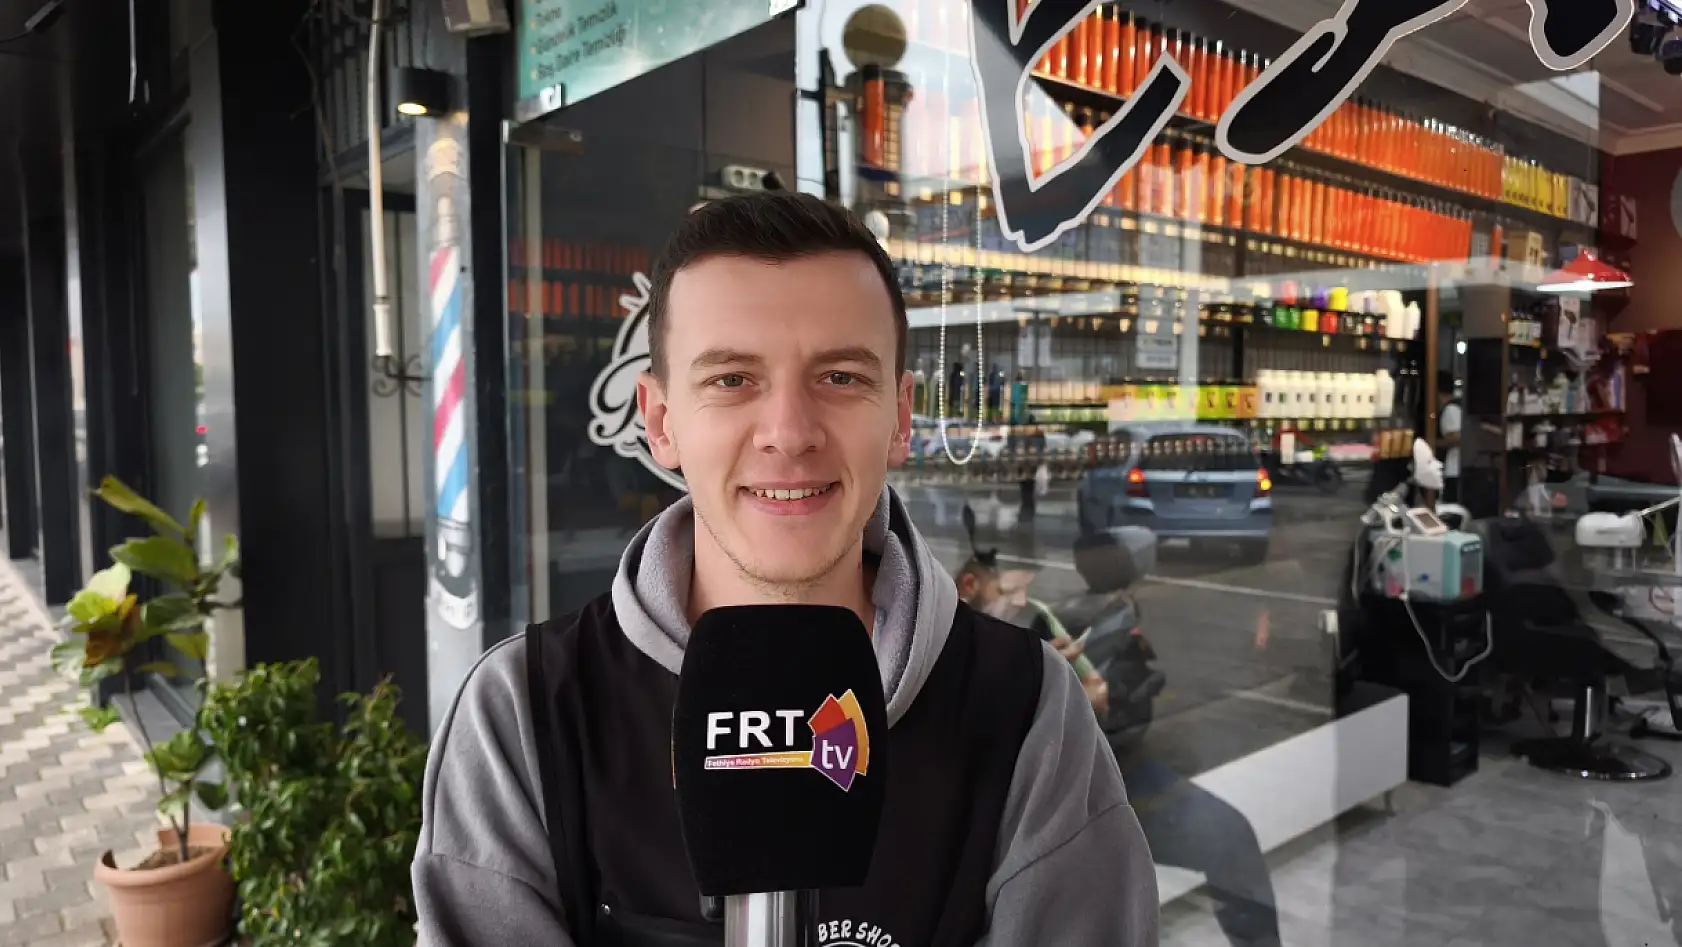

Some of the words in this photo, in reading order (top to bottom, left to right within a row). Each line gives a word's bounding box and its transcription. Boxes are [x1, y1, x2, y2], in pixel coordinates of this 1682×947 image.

[706, 709, 805, 750] FRT
[821, 739, 854, 770] tv
[818, 919, 852, 942] BER
[855, 921, 900, 947] SHO
